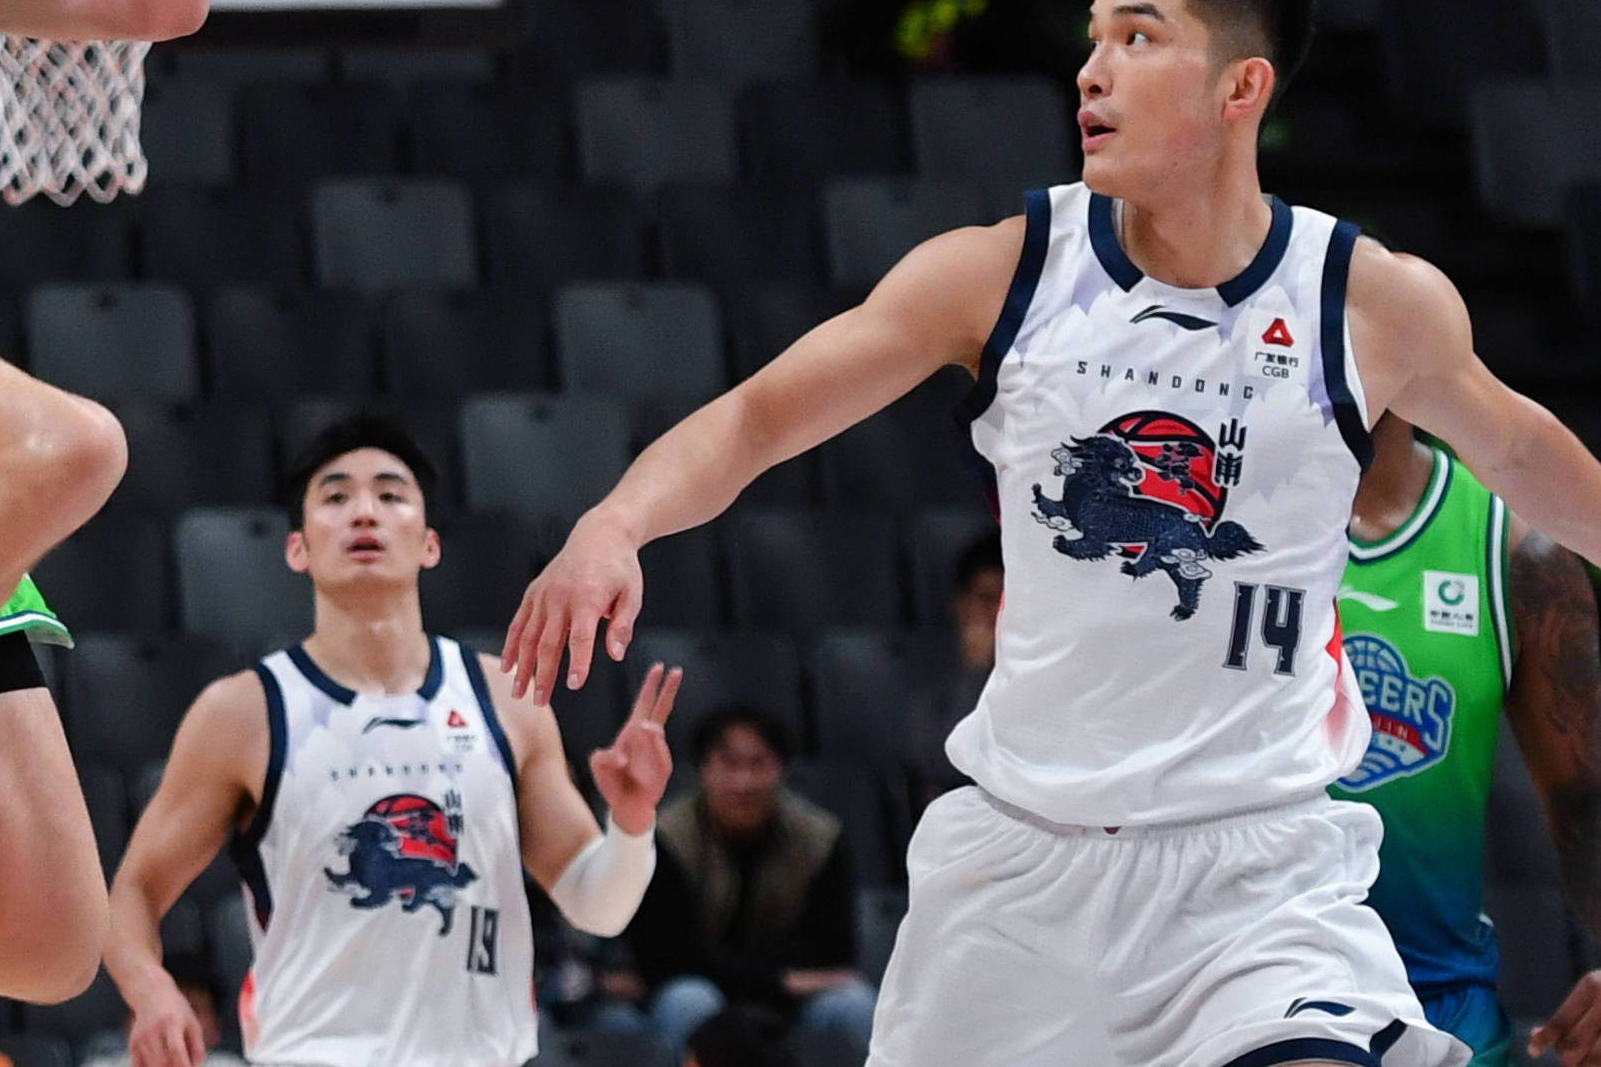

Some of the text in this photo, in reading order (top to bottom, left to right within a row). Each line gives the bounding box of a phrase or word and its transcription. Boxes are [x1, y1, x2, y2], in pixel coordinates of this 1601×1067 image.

[1262, 365, 1290, 379] CGB
[1221, 581, 1307, 677] 14
[465, 904, 500, 978] 19
